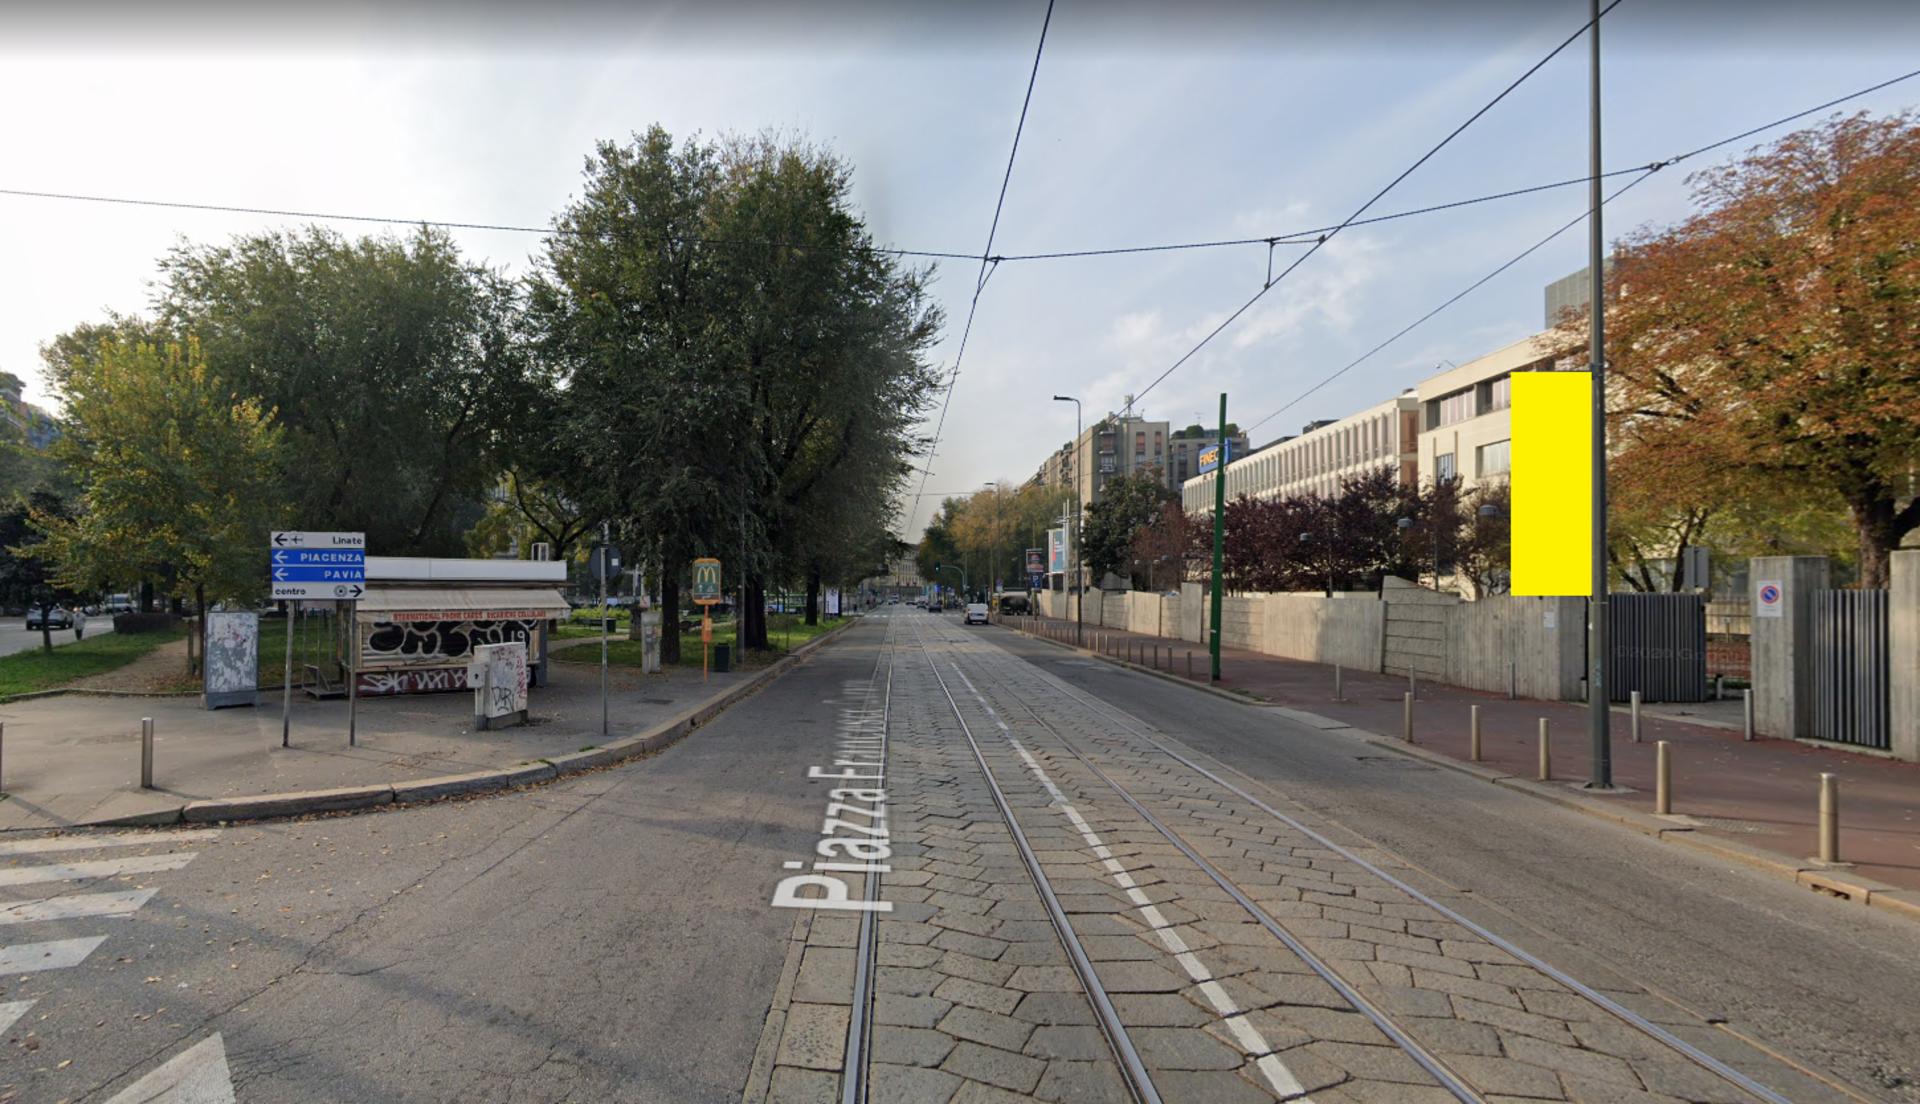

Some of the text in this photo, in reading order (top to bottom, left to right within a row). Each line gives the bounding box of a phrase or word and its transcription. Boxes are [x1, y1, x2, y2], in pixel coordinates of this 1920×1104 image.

[1200, 449, 1218, 466] FINEC
[333, 536, 362, 545] Linate
[301, 553, 362, 562] PIACENZA
[324, 570, 362, 579] PAVIA
[275, 587, 306, 595] centro
